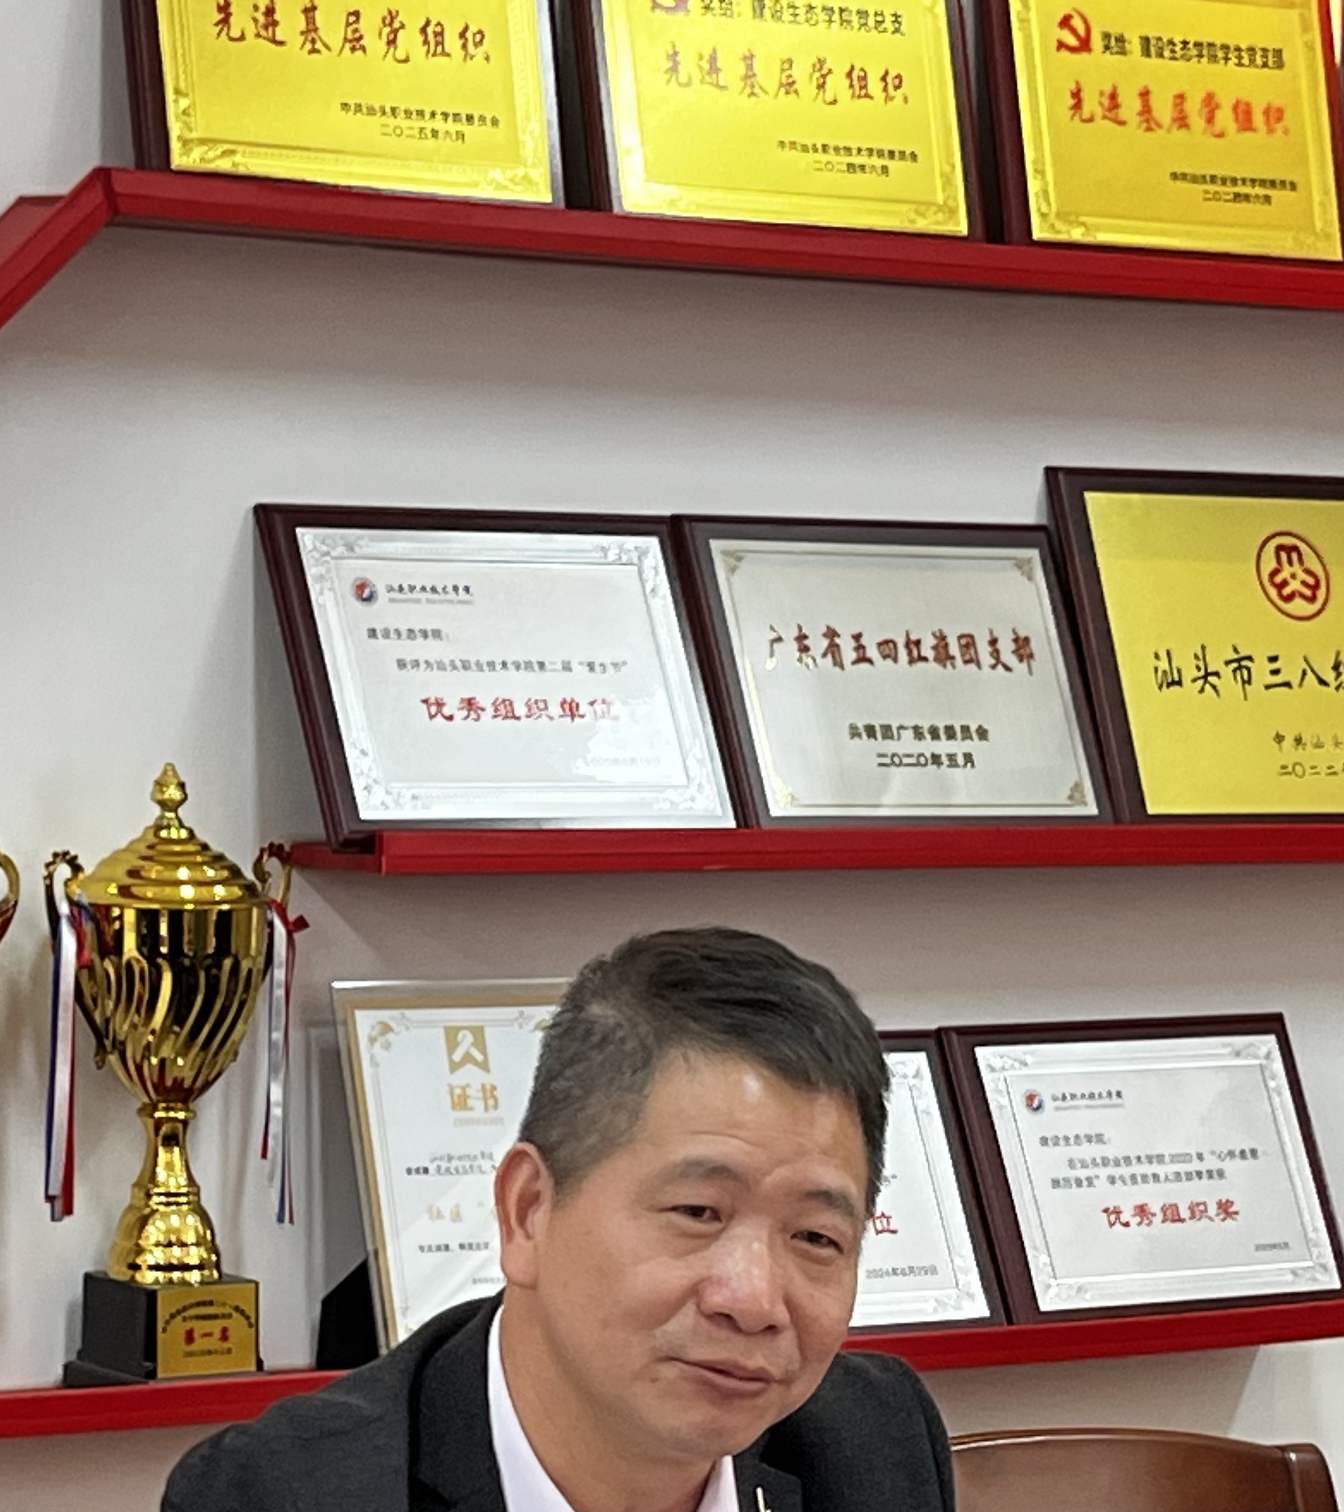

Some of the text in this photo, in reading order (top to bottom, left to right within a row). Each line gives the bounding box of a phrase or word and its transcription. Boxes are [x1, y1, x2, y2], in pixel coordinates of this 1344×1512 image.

[212, 0, 491, 65] 先进基层党组织
[663, 41, 909, 106] 先进基层党组织
[1068, 80, 1290, 138] 先进基层党组织
[765, 622, 1037, 676] 广东省五四红旗团支部
[419, 696, 620, 723] 优秀组织单位
[447, 1082, 500, 1114] 证书
[1101, 1198, 1241, 1230] 优秀组织奖
[184, 1326, 230, 1348] 第一名
